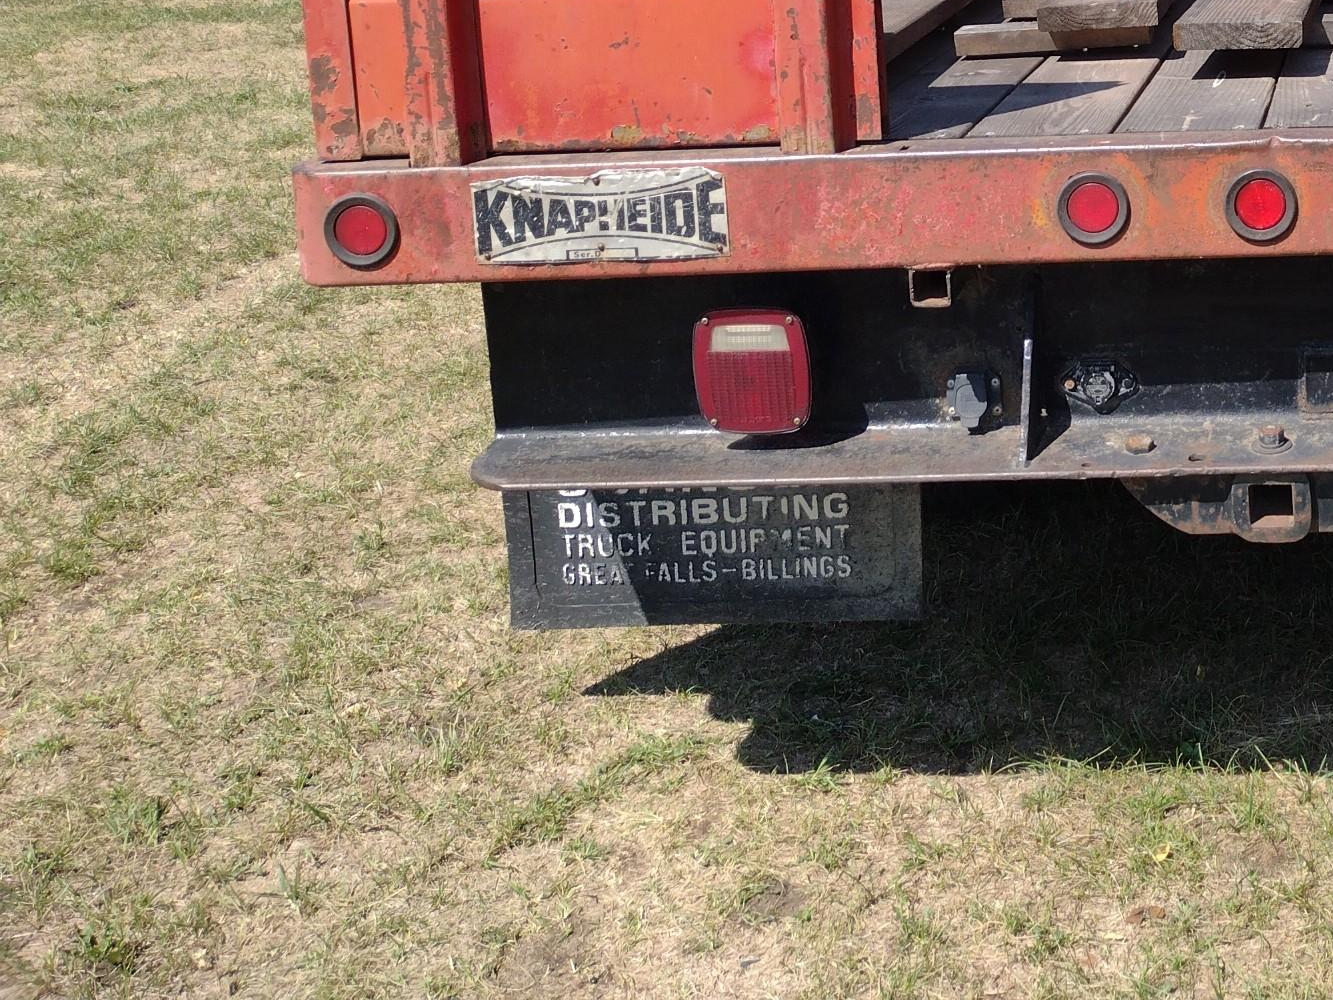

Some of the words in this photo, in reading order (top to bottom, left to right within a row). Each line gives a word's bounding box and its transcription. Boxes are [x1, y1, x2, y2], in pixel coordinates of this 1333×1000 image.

[474, 180, 727, 255] KNAPHEIDE
[557, 492, 851, 528] DISTRIBUTING
[562, 532, 653, 558] TRUCK
[681, 524, 851, 558] EQUIPMENT
[562, 562, 634, 585] GREA
